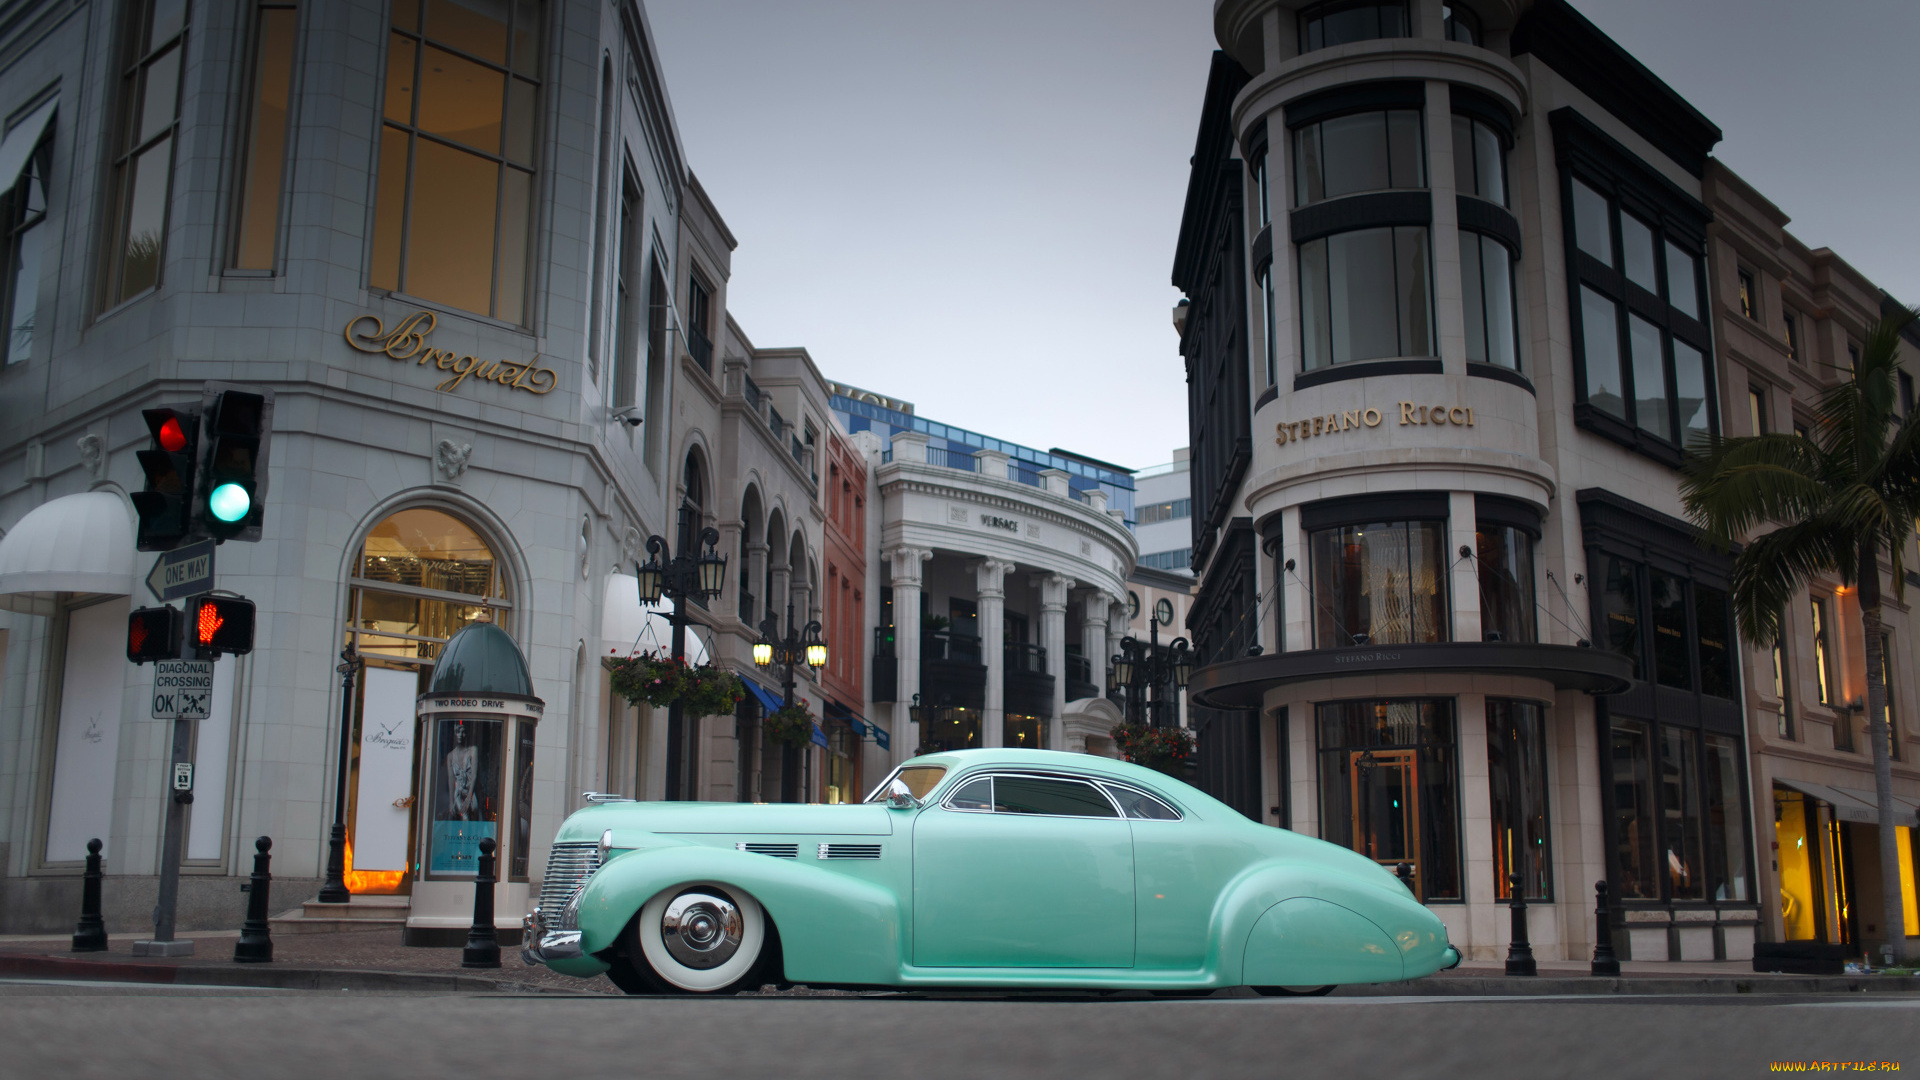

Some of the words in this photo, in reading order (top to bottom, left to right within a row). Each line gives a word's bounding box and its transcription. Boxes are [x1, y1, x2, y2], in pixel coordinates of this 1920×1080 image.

[345, 311, 557, 393] Breguet
[1276, 408, 1382, 445] STEFANO
[1399, 401, 1475, 427] RICCI
[981, 514, 1018, 532] VERSACE
[165, 565, 185, 585] ONE
[187, 557, 207, 579] WAY
[417, 642, 434, 658] 280
[159, 663, 210, 673] DIAGONAL
[157, 676, 210, 687] CROSSING
[155, 694, 175, 713] OK
[450, 699, 477, 707] RODEO
[481, 700, 505, 708] DRIVE
